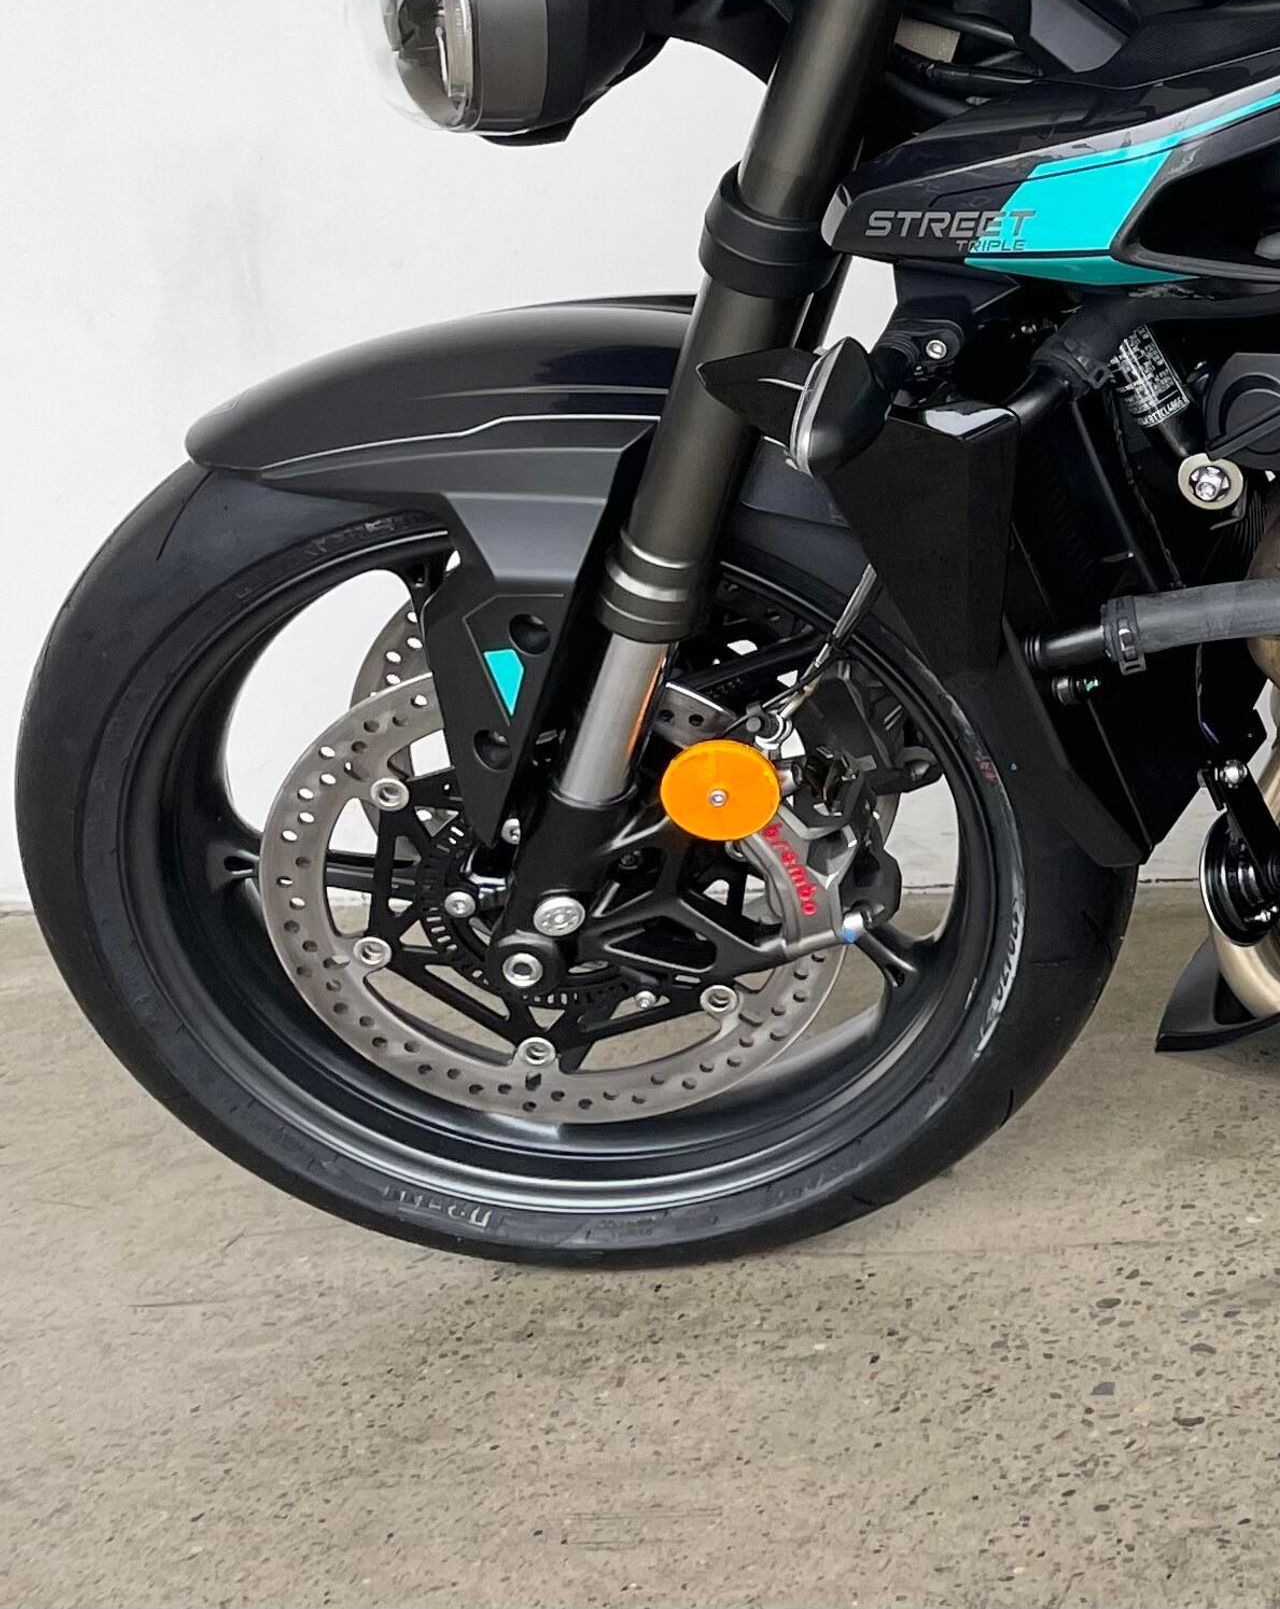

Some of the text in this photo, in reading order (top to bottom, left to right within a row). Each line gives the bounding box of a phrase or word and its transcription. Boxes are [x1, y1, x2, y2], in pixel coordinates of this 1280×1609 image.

[864, 209, 1037, 239] STREET
[956, 239, 1026, 253] TRIPLE
[761, 822, 818, 916] brembo
